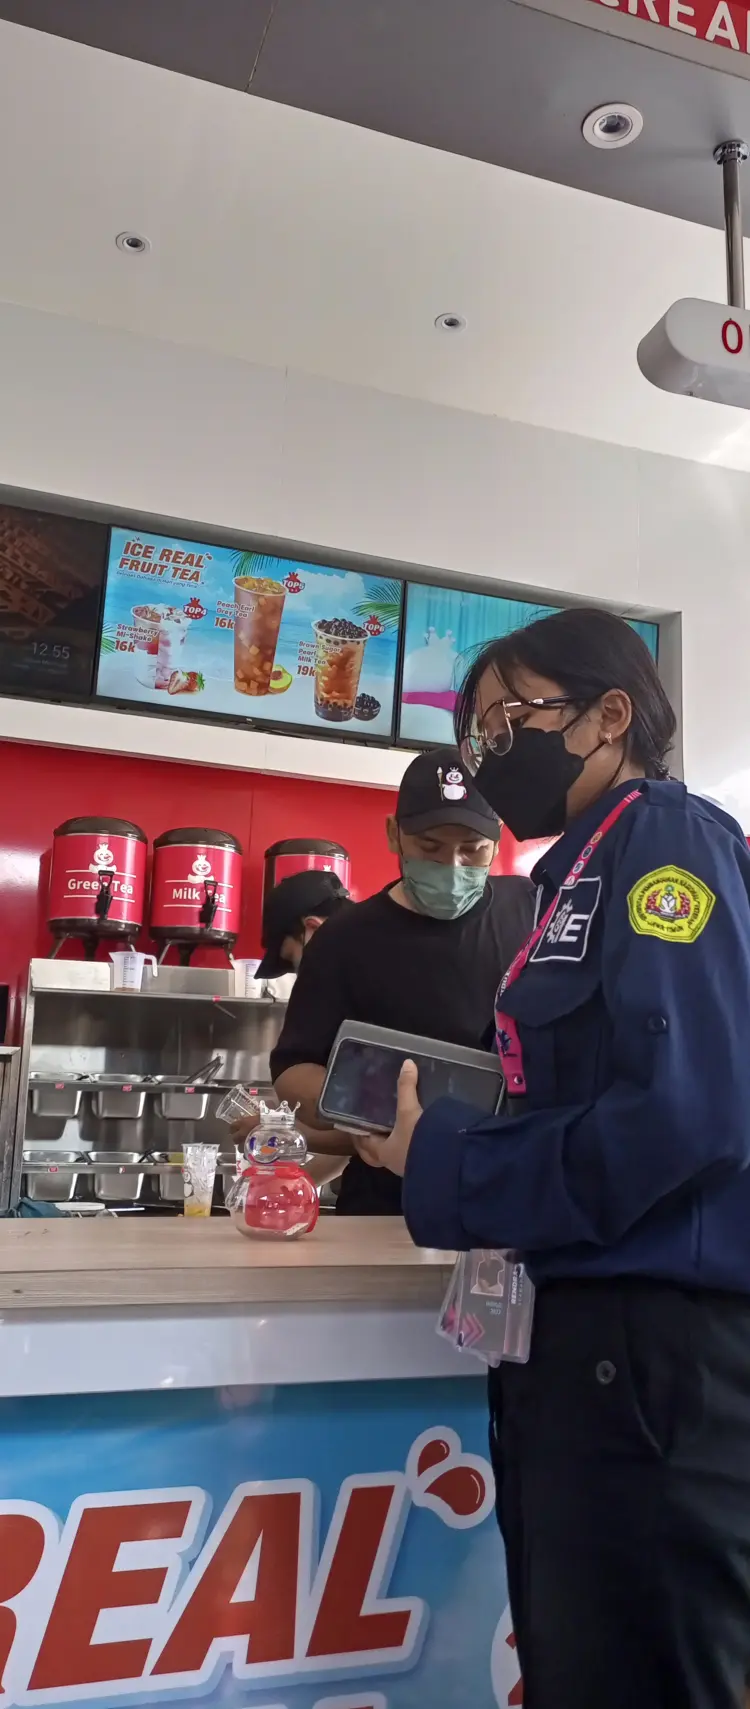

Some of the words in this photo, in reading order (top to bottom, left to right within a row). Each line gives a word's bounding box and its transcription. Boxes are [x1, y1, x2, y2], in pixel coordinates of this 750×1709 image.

[721, 319, 750, 354] O
[123, 541, 155, 559] ICE
[159, 548, 204, 568] REAL
[119, 557, 168, 576] FRUIT
[172, 566, 200, 582] TEA
[216, 600, 239, 610] Peach
[214, 617, 235, 629] 16k
[117, 624, 159, 636] Strawberry
[115, 640, 135, 652] 16k
[297, 665, 316, 677] 19k
[112, 880, 133, 895] Tea
[172, 887, 201, 900] Milk
